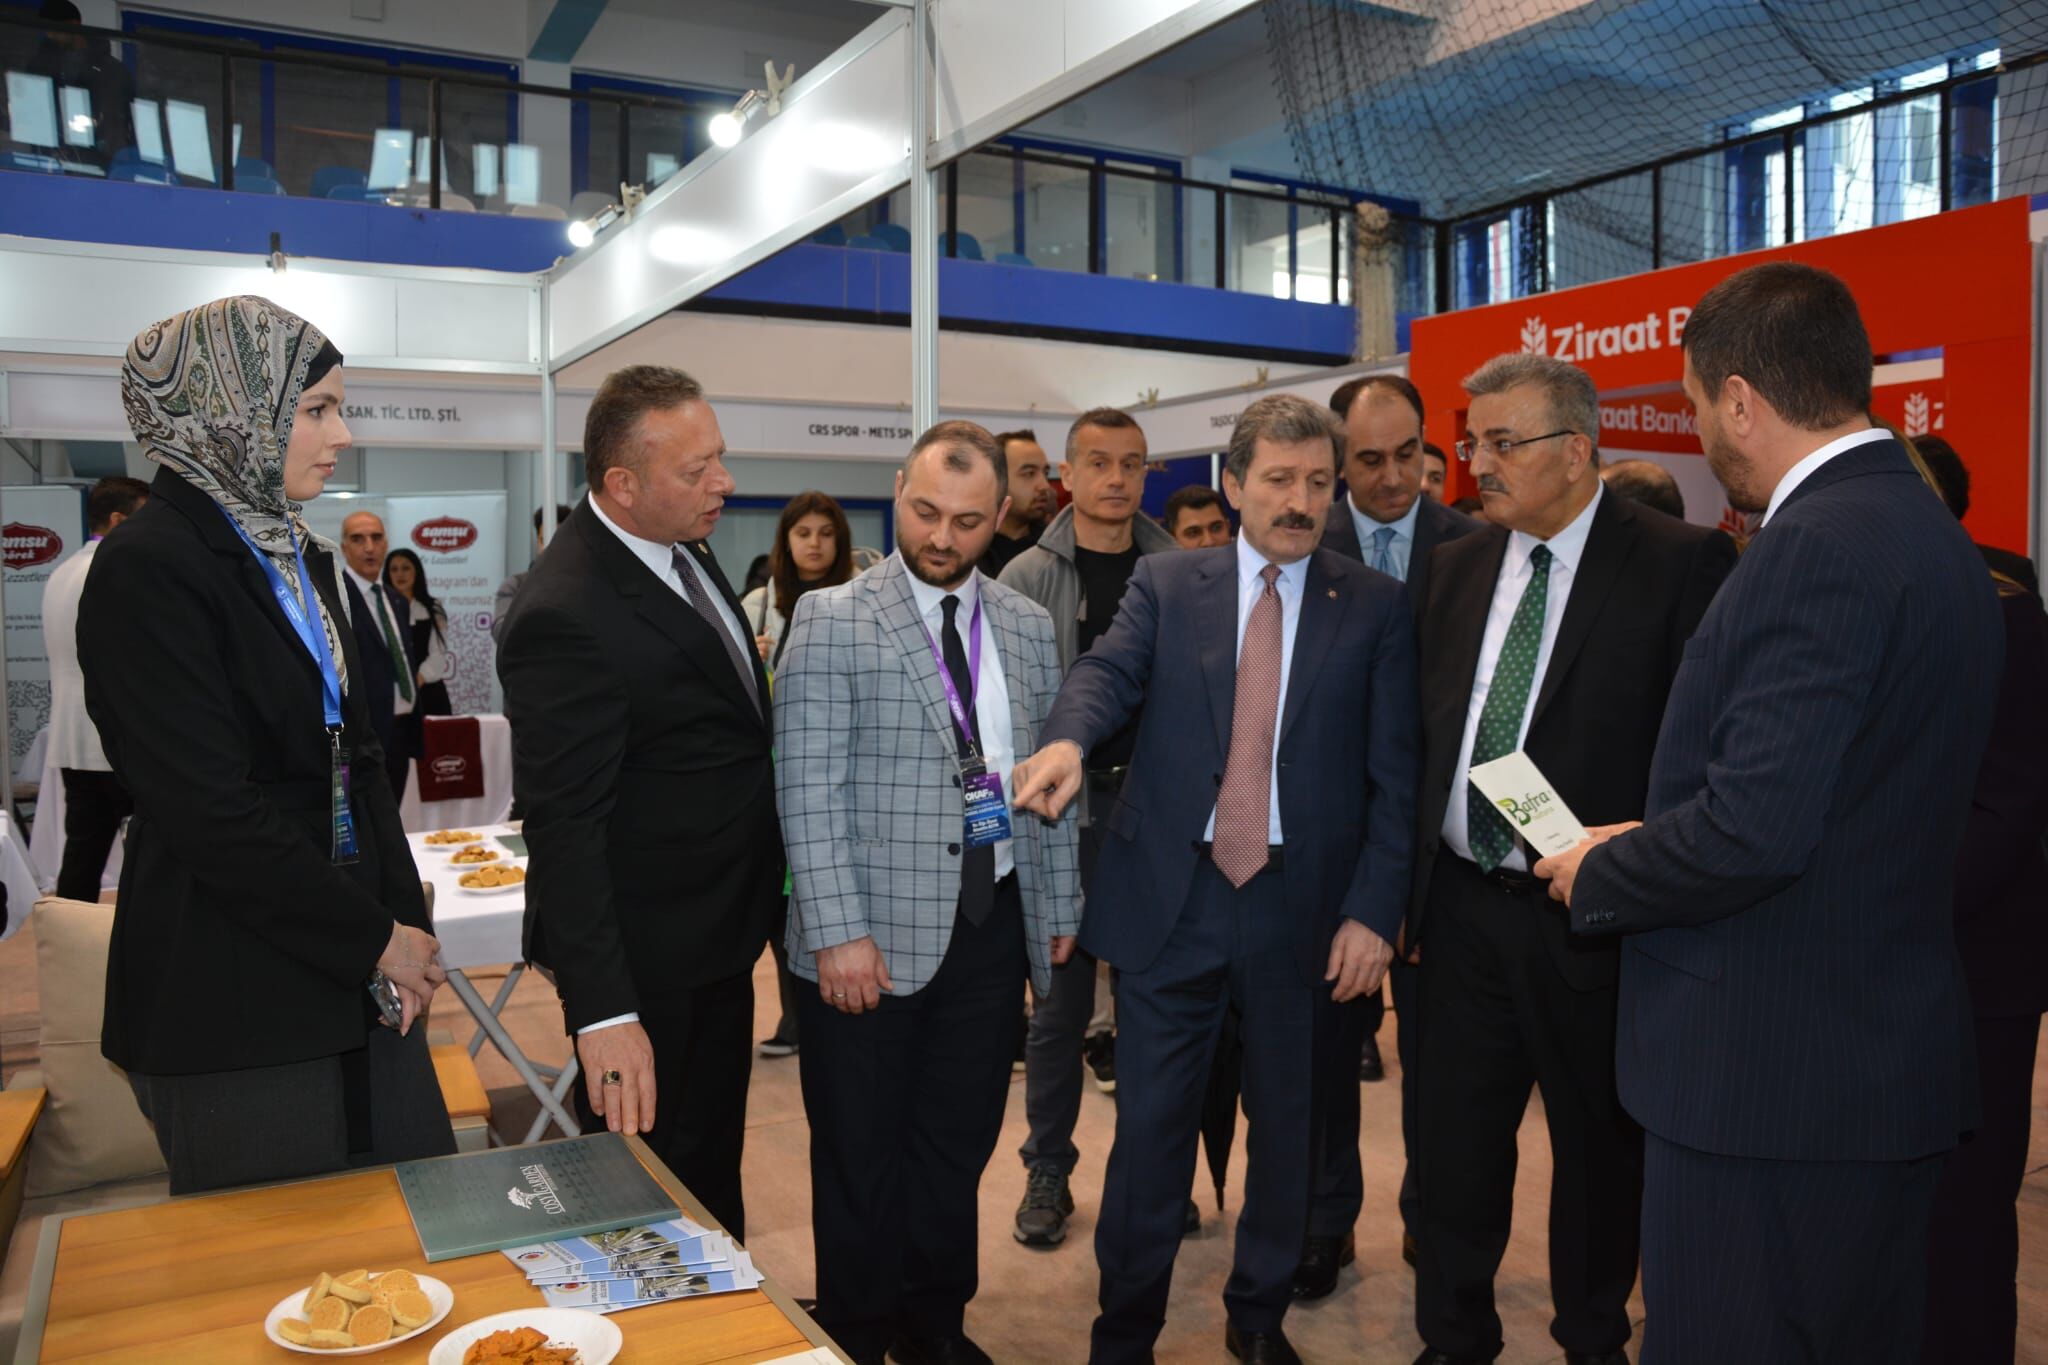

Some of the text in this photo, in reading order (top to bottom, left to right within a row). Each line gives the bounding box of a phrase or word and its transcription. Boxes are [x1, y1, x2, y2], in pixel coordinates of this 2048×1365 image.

[1552, 312, 1662, 363] Ziraat
[346, 405, 378, 419] SAN.
[381, 404, 405, 420] TİC.
[408, 407, 435, 421] LTD.
[437, 406, 461, 422] ŞTİ.
[808, 424, 829, 436] CRS
[831, 424, 860, 437] SPOR
[869, 426, 896, 439] METS
[897, 427, 913, 440] SP
[1496, 791, 1552, 827] Bafra
